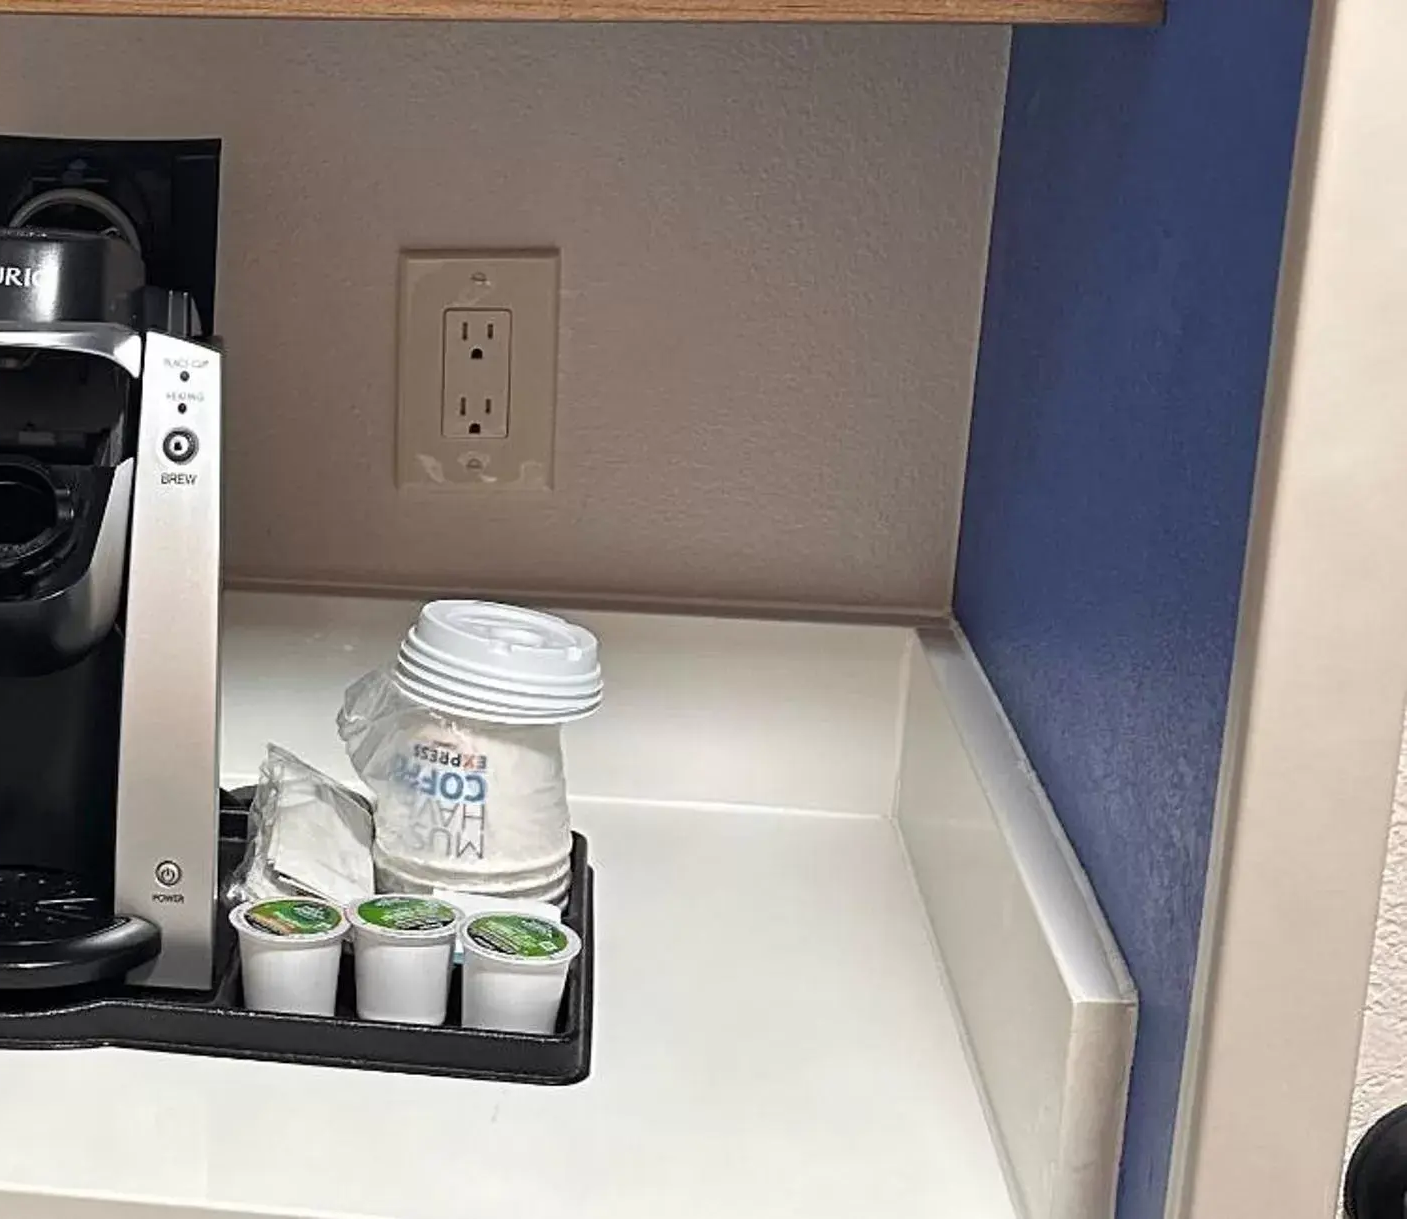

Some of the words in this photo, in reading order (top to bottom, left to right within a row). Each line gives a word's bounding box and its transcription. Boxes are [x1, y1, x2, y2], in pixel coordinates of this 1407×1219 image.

[160, 472, 198, 485] BREW
[413, 744, 487, 770] EXPRESS
[404, 799, 485, 831] HAV
[405, 822, 485, 860] MUS
